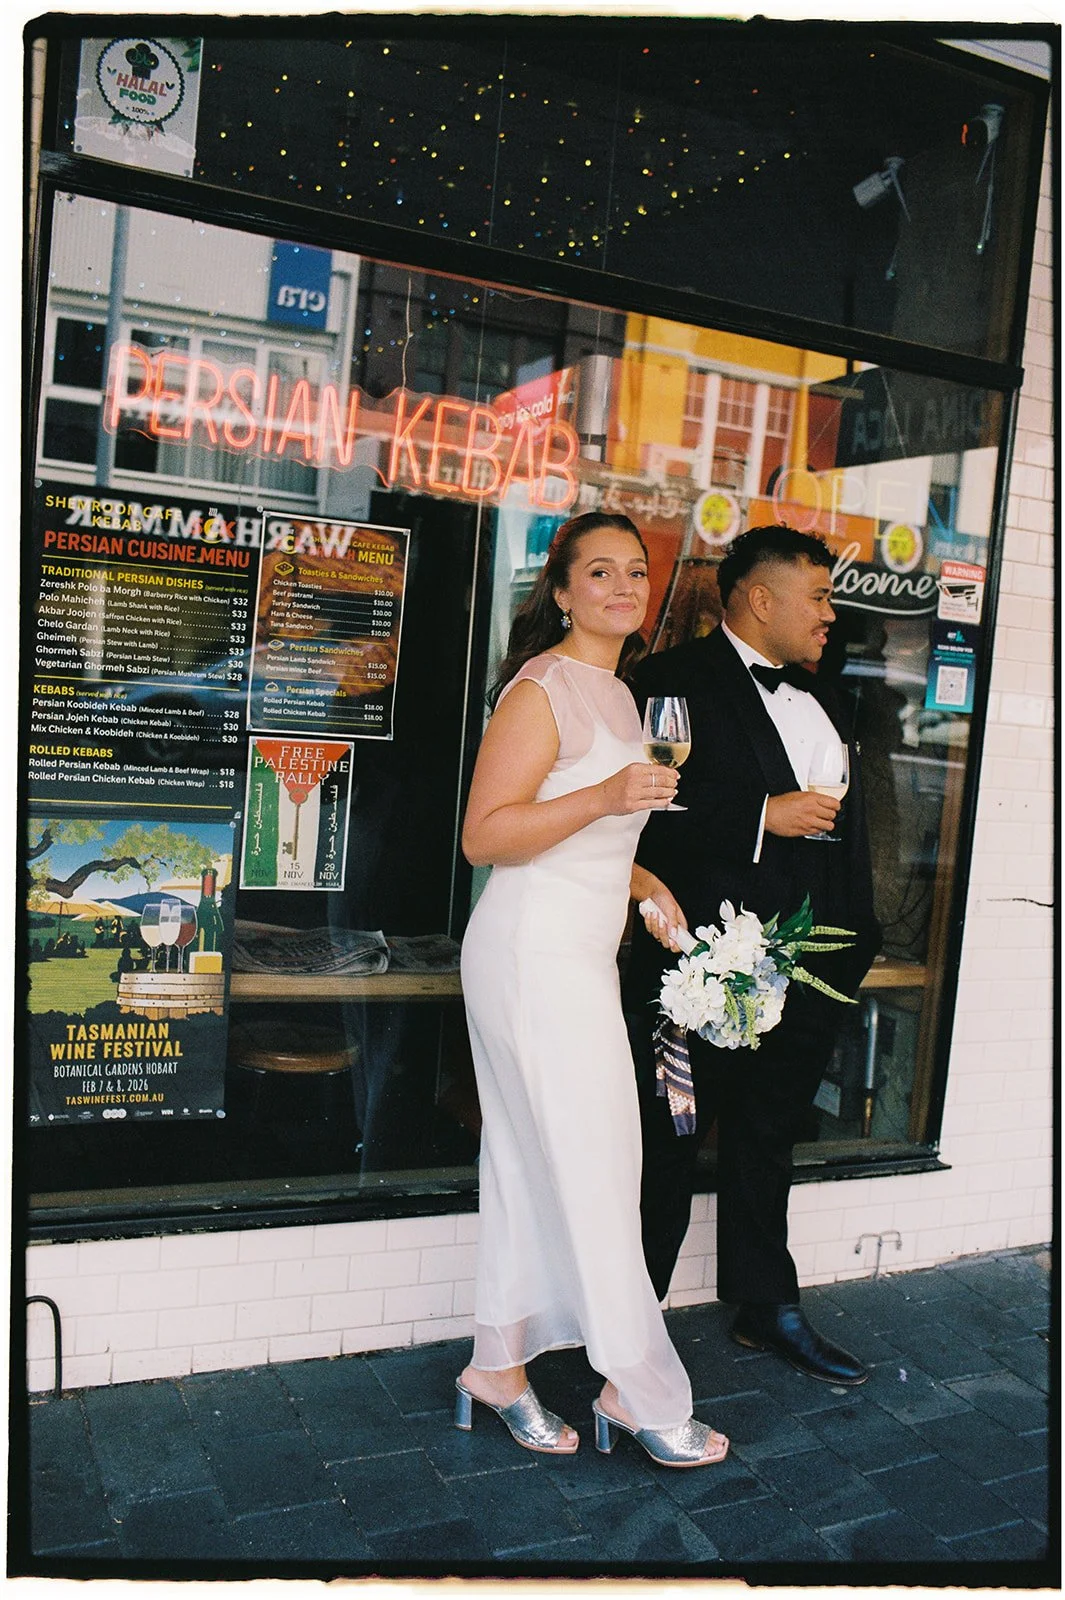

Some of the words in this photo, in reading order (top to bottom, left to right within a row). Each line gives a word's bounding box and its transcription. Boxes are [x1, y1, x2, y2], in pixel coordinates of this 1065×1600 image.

[116, 73, 167, 97] HALAL
[119, 88, 156, 105] FOOD
[132, 106, 150, 115] 100%
[110, 344, 360, 466] PERSIAN
[389, 387, 581, 511] KEBAB
[91, 515, 143, 531] KEBAB
[143, 507, 183, 523] CAFE
[44, 530, 123, 556] PERSIAN
[128, 539, 196, 562] CUISINE
[200, 550, 250, 568] MENU
[358, 551, 394, 566] MENU
[41, 565, 114, 581] TRADITIONAL
[117, 573, 163, 586] PERSIAN
[166, 577, 203, 589] DISHES
[298, 567, 330, 578] Toasties
[331, 571, 337, 579] &
[338, 571, 383, 584] Sandwiches
[830, 541, 937, 599] lcome
[944, 566, 983, 580] WARNING
[40, 578, 76, 590] Zereshk
[77, 581, 97, 592] Polo
[99, 583, 111, 593] ba
[113, 585, 142, 597] Morgh
[232, 595, 248, 605] $32
[374, 588, 394, 597] $10.00
[39, 591, 60, 601] Polo
[61, 593, 105, 606] Mahicheh
[231, 609, 248, 619] $33
[373, 598, 393, 607] $10.00
[38, 605, 65, 615] Akbar
[230, 621, 247, 631] $33
[372, 608, 393, 617] $10.00
[37, 618, 64, 629] Chelo
[65, 620, 98, 632] Gardan
[230, 634, 246, 644] $33
[371, 619, 392, 628] $10.00
[370, 629, 391, 638] $10.00
[36, 631, 77, 643] Gheimeh
[228, 646, 245, 656] $33
[289, 644, 318, 652] Persian
[319, 646, 364, 656] Sandwiches
[35, 644, 78, 656] Ghormeh
[79, 648, 104, 658] Sabzi
[228, 659, 244, 669] $30
[35, 657, 82, 671] Vegetarian
[84, 661, 125, 672] Ghormeh
[126, 664, 150, 674] Sabzi
[227, 671, 243, 681] $28
[367, 661, 388, 670] $15.00
[367, 671, 387, 680] $15.00
[33, 685, 75, 695] KEBABS
[286, 686, 314, 695] Persian
[315, 689, 347, 697] Specials
[32, 698, 65, 709] Persian
[67, 700, 108, 711] Koobideh
[109, 702, 137, 713] Kebab
[224, 709, 240, 718] $28
[364, 703, 384, 712] $18.00
[31, 710, 64, 721] Persian
[65, 712, 89, 724] Jojeh
[91, 714, 119, 724] Kebab
[223, 722, 239, 731] $30
[363, 713, 383, 722] $18.00
[30, 724, 47, 733] Mix
[48, 725, 83, 735] Chicken
[84, 726, 92, 736] &
[93, 727, 134, 738] Koobideh
[222, 734, 238, 743] $30
[28, 744, 70, 756] ROLLED
[72, 746, 113, 758] KEBABS
[281, 746, 325, 759] FREE
[28, 758, 57, 768] Rolled
[58, 759, 91, 770] Persian
[93, 761, 120, 771] Kebab
[220, 766, 235, 776] $18
[254, 757, 349, 773] PALESTINE
[28, 771, 57, 781] Rolled
[58, 772, 90, 782] Persian
[92, 774, 127, 784] Chicken
[128, 775, 155, 785] Kebab
[219, 779, 234, 789] $18
[275, 771, 329, 786] RALLY
[319, 872, 339, 880] NOV
[66, 1023, 169, 1041] TASMANIAN
[50, 1043, 96, 1060] WINE
[103, 1041, 183, 1059] FESTIVAL
[53, 1064, 102, 1078] BOTANICAL
[105, 1062, 143, 1076] GARDENS
[146, 1061, 178, 1075] HOBART
[82, 1080, 96, 1093] FEB
[99, 1080, 104, 1092] 7
[106, 1080, 114, 1092] &
[127, 1078, 149, 1092] 2026
[65, 1093, 164, 1105] TASWINEFEST.COM.AU
